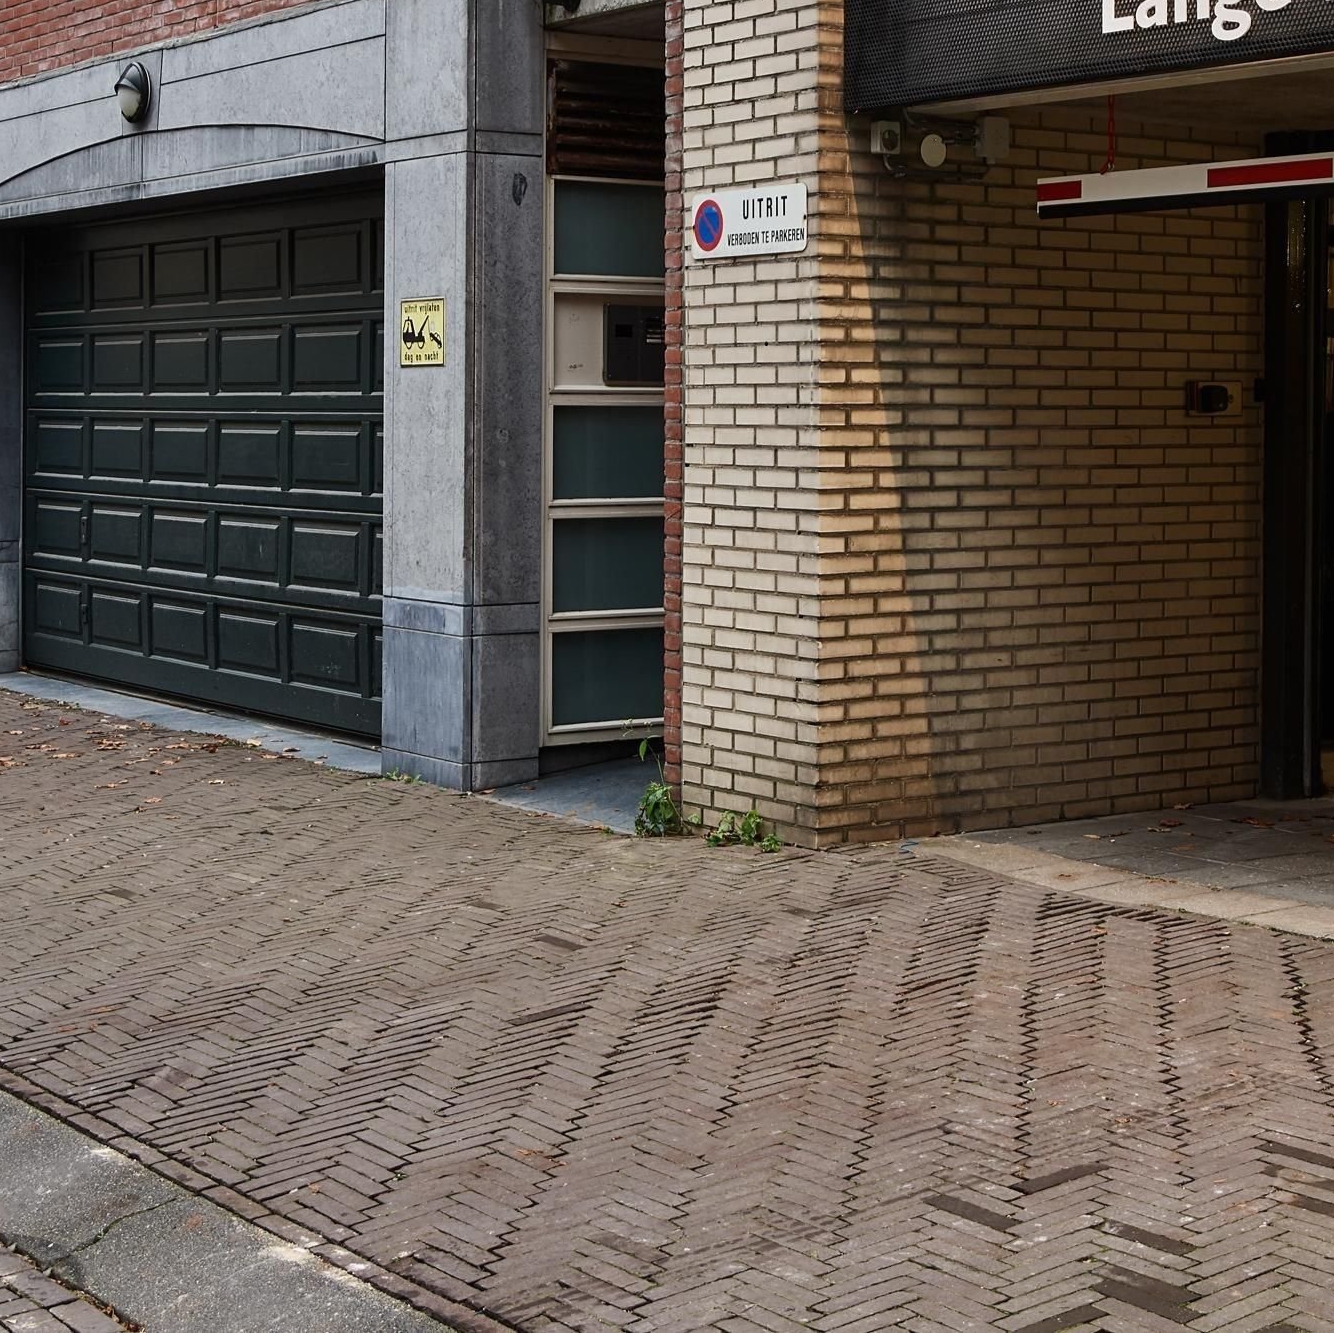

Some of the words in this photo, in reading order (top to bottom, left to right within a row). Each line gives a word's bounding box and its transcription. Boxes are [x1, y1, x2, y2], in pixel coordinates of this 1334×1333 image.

[743, 196, 787, 219] UITRIT
[728, 232, 759, 246] VERBODEN
[762, 231, 769, 243] TE
[771, 228, 804, 242] PARKEREN
